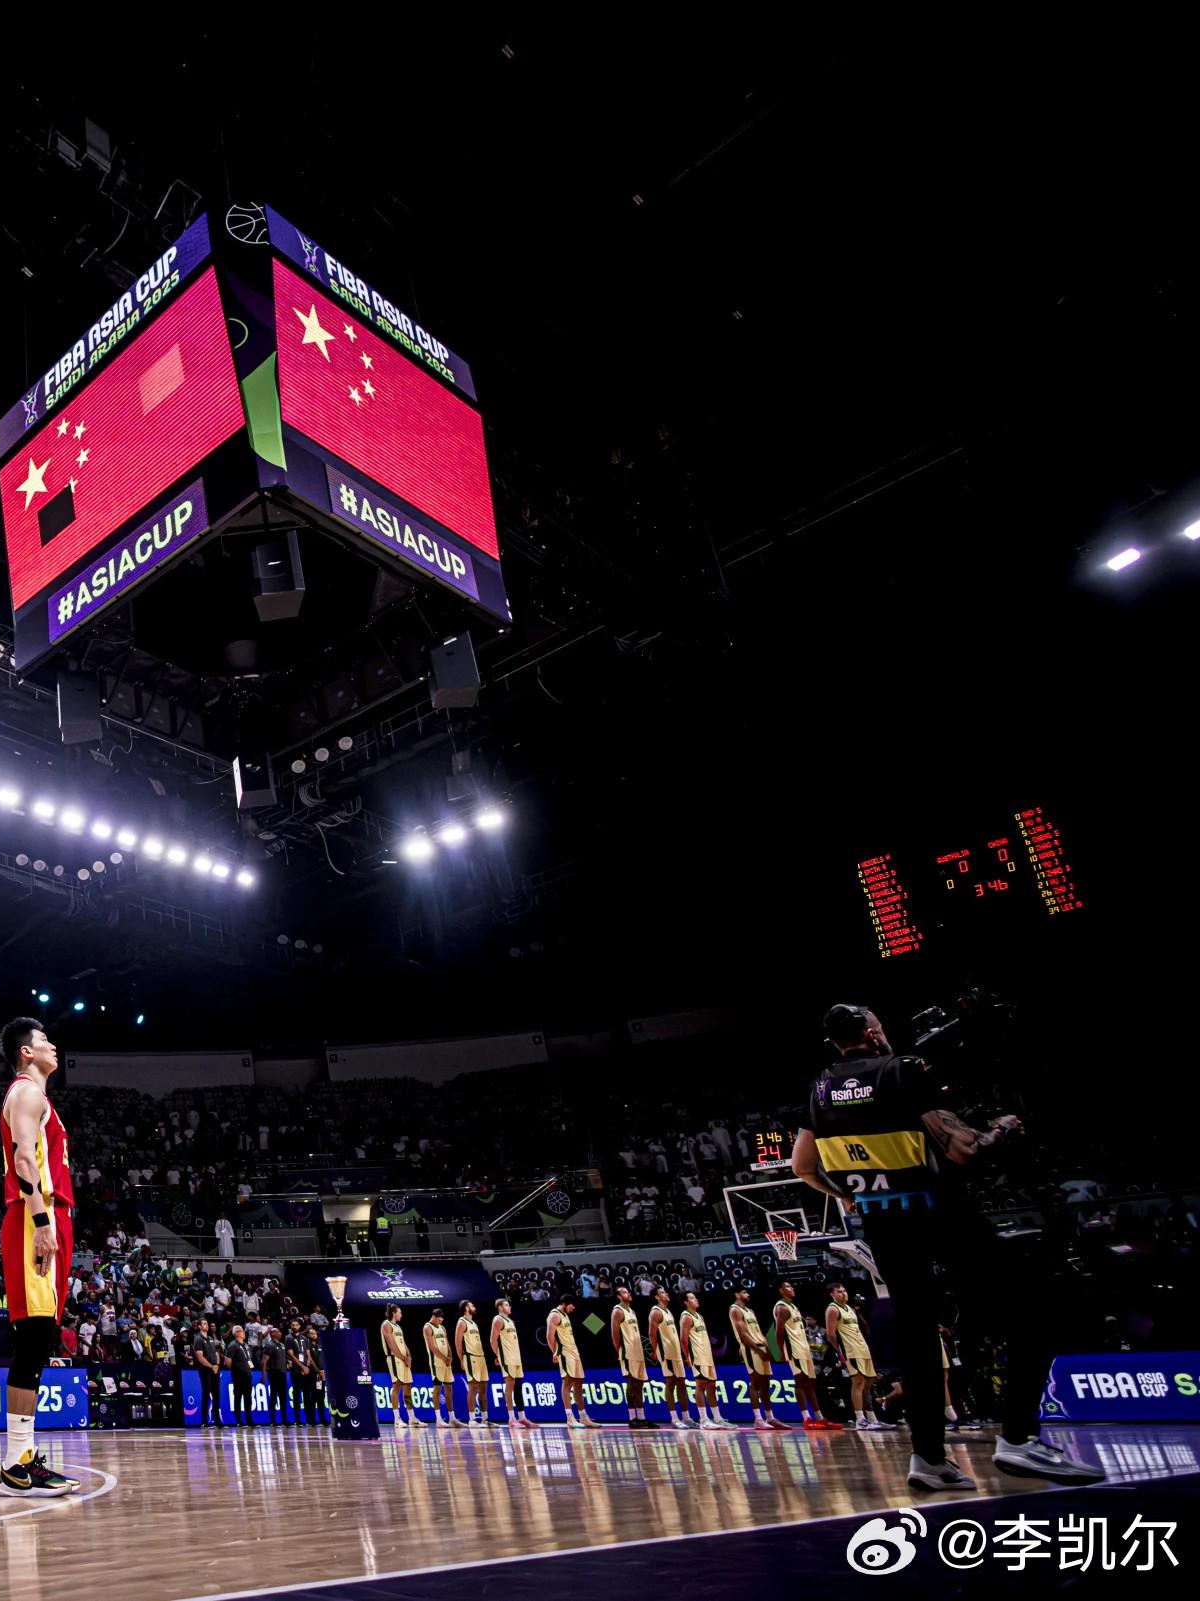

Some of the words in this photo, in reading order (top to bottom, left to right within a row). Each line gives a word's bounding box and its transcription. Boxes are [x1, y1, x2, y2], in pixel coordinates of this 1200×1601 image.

[324, 252, 370, 306] FIBA
[372, 290, 414, 339] ASIA
[416, 325, 449, 364] CUP
[44, 340, 85, 396] FIBA
[88, 292, 132, 352] ASIA
[136, 246, 177, 302] CUP
[46, 362, 85, 410] SAUDI
[88, 308, 140, 369] ARABIA
[144, 269, 180, 314] 2025
[330, 278, 372, 320] SAUDI
[376, 315, 423, 360] ARABIA
[425, 352, 455, 383] 2025
[340, 483, 466, 579] #ASIACUP
[57, 500, 193, 625] #ASIACUP
[998, 849, 1008, 861] 0
[959, 860, 968, 872] 0
[1008, 862, 1016, 872] 0
[946, 880, 954, 890] 0
[974, 884, 984, 896] 3
[988, 880, 1008, 891] 46
[832, 1090, 852, 1100] ASIA
[854, 1086, 872, 1098] CUP
[756, 1134, 764, 1144] 3
[766, 1132, 782, 1142] 46
[757, 1145, 780, 1163] 24
[844, 1144, 870, 1162] HB
[733, 1380, 798, 1403] 225
[1070, 1372, 1139, 1398] FIBA
[1136, 1372, 1166, 1384] ASIA
[1140, 1384, 1168, 1397] CUP
[37, 1386, 62, 1412] 25
[492, 1382, 536, 1407] FA
[536, 1383, 556, 1394] ASIA
[538, 1394, 557, 1406] CUP
